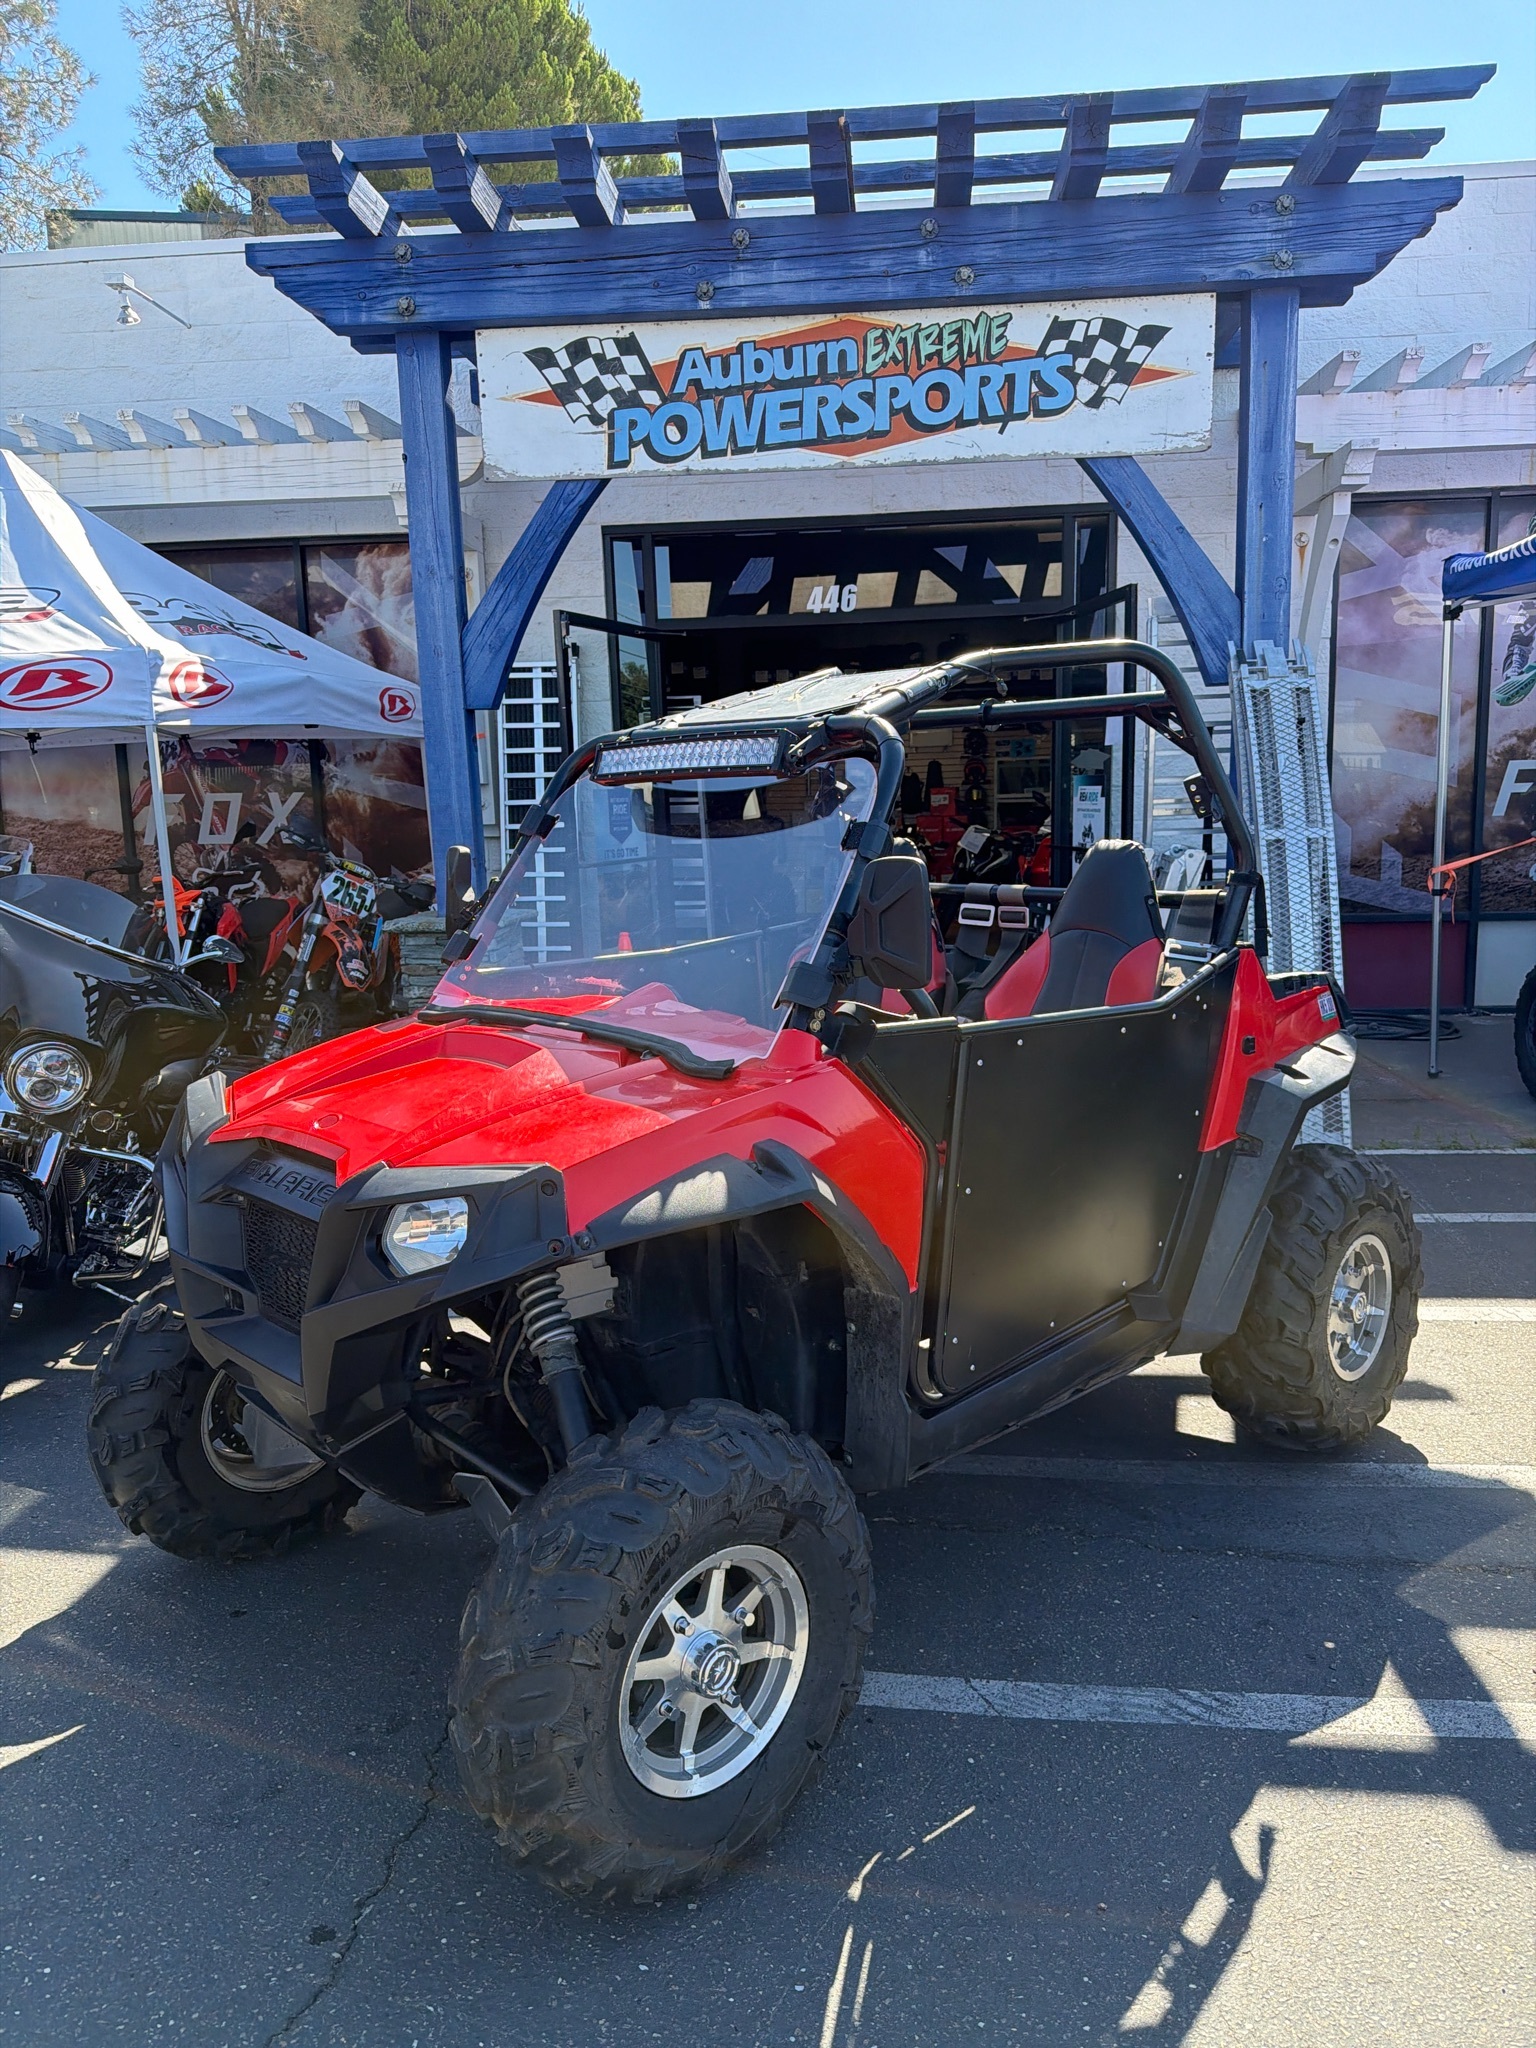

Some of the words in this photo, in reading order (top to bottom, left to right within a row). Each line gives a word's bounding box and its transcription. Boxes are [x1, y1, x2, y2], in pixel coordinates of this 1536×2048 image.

[673, 338, 858, 394] Auburn
[865, 311, 1012, 374] EXTREME
[612, 354, 1076, 464] POWERSPORTS
[806, 584, 858, 614] 446
[143, 792, 305, 845] FOX
[625, 847, 639, 857] TIME
[238, 1158, 337, 1208] POLARIS
